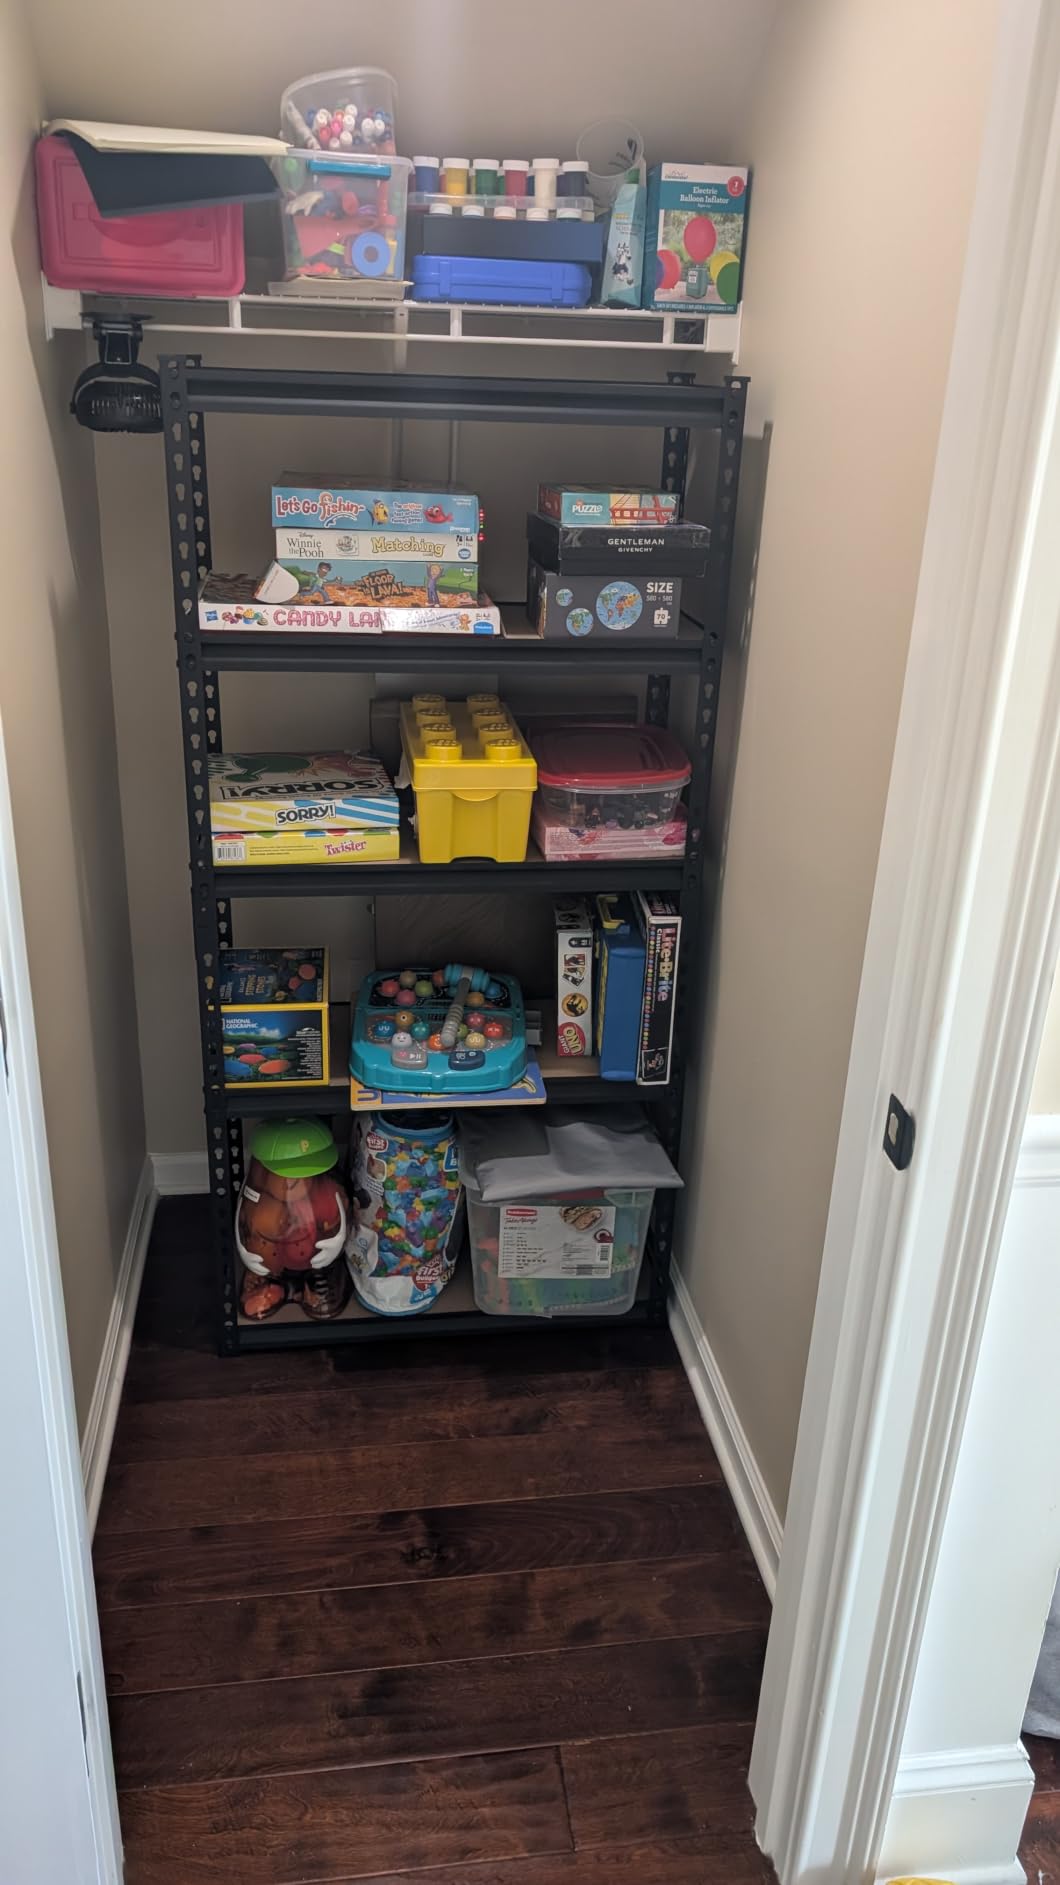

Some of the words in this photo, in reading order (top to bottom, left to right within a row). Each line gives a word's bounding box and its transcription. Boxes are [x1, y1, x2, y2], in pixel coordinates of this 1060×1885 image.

[680, 194, 705, 203] Balloon
[705, 196, 729, 204] Inflator
[692, 186, 718, 195] Electric
[276, 496, 300, 517] Let's
[302, 499, 318, 513] Go
[286, 537, 322, 548] Winnie
[371, 537, 447, 558] Matching
[288, 547, 299, 555] the
[299, 547, 324, 559] Pooh
[362, 574, 395, 588] FLOOR
[646, 582, 674, 593] SIZE
[272, 608, 342, 627] CANDY
[224, 779, 379, 799] SORRY!
[277, 803, 336, 825] SORRY!
[324, 840, 367, 857] Twister
[559, 1035, 570, 1054] GIANT
[564, 1025, 583, 1055] UNO
